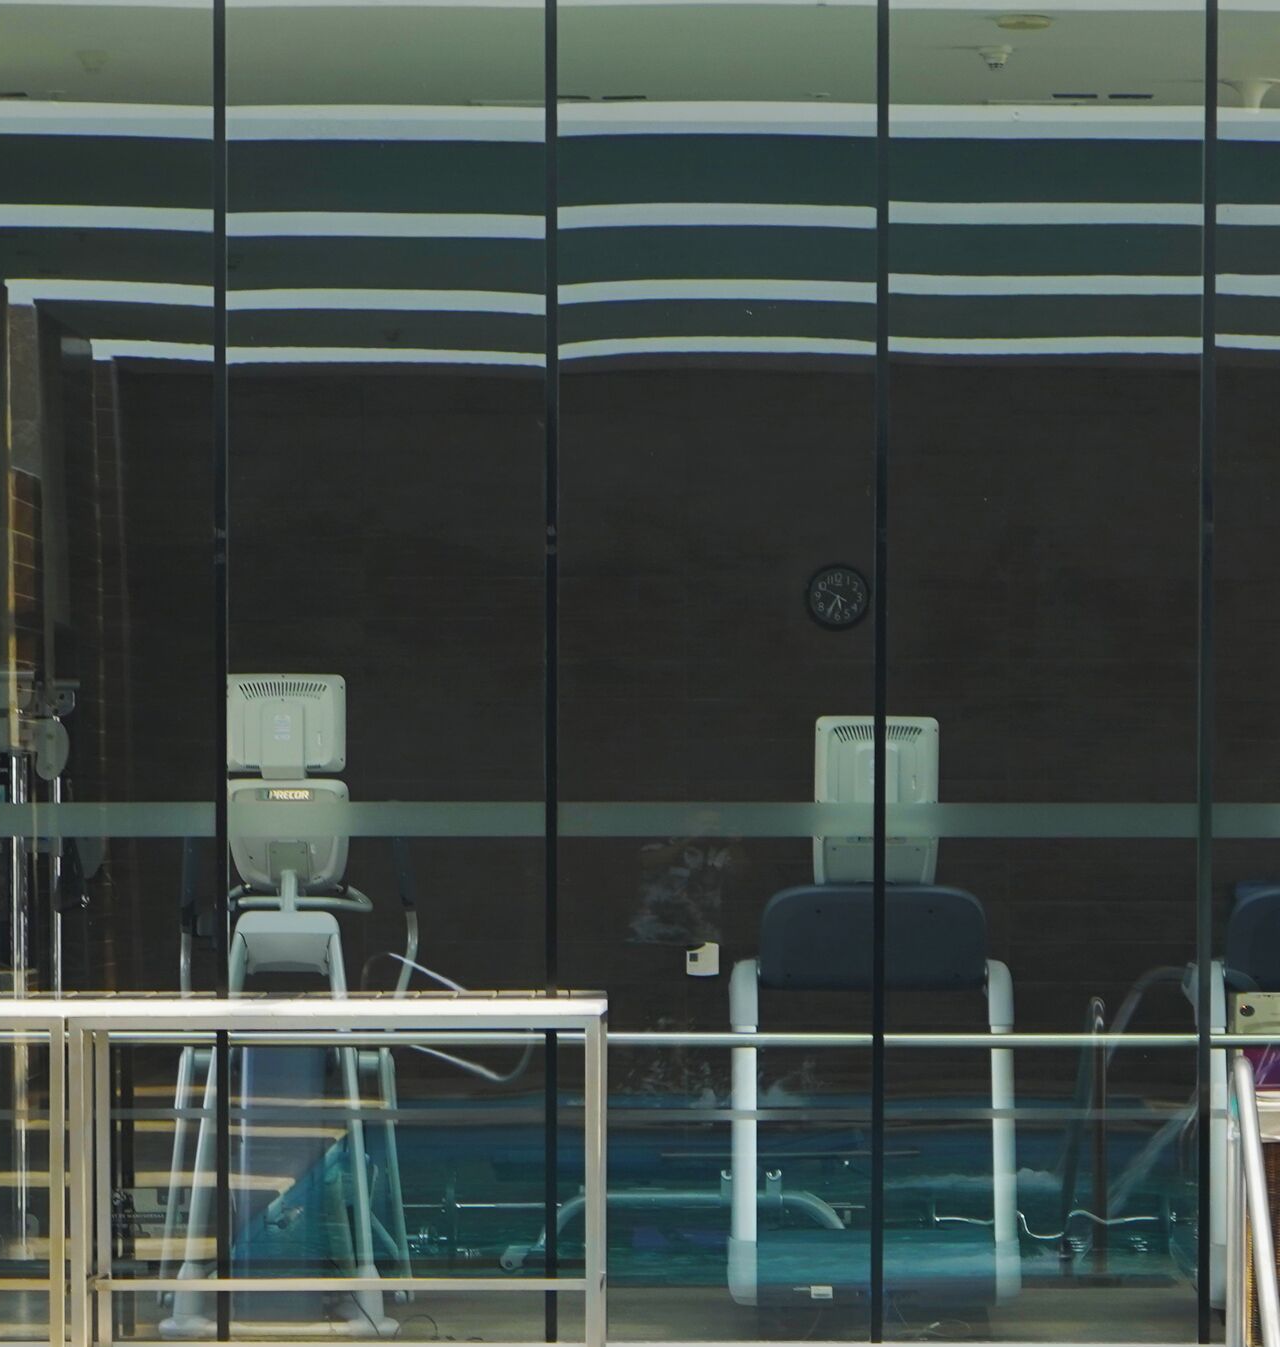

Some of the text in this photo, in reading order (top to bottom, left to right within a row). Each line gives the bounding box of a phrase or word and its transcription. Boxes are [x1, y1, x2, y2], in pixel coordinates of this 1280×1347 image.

[834, 572, 843, 583] 12
[851, 581, 858, 592] 2
[814, 591, 822, 600] 9
[856, 592, 863, 602] 3
[817, 601, 825, 612] 8
[850, 603, 858, 612] 4
[834, 611, 841, 621] 6
[844, 608, 851, 619] 5
[268, 789, 310, 800] PRECOR
